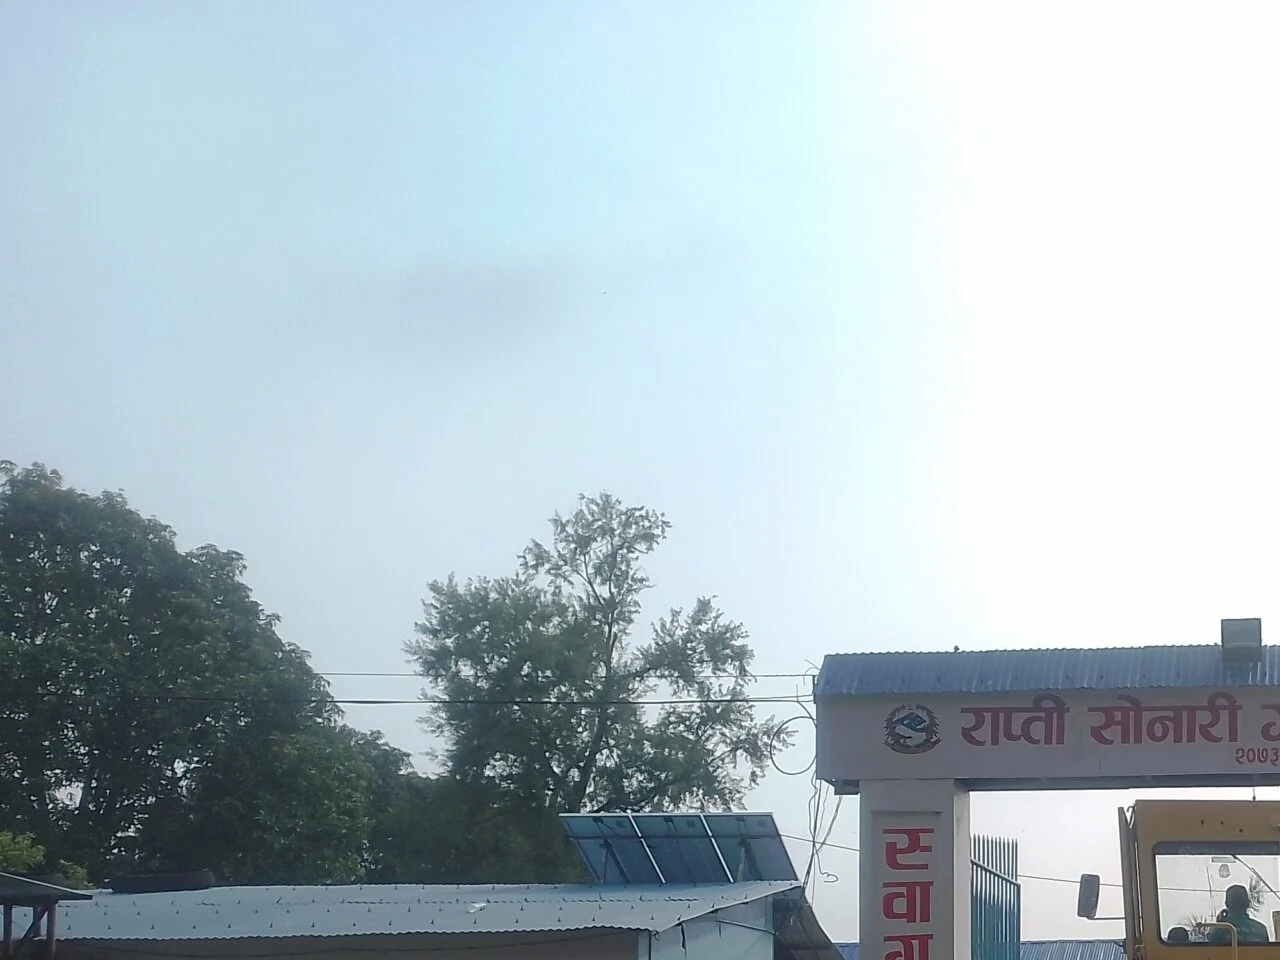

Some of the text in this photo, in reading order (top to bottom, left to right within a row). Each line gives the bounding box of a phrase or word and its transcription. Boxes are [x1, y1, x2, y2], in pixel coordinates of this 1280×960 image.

[960, 693, 1070, 747] राप्ती
[1087, 692, 1243, 746] सोनारी
[1235, 747, 1280, 767] २०७३
